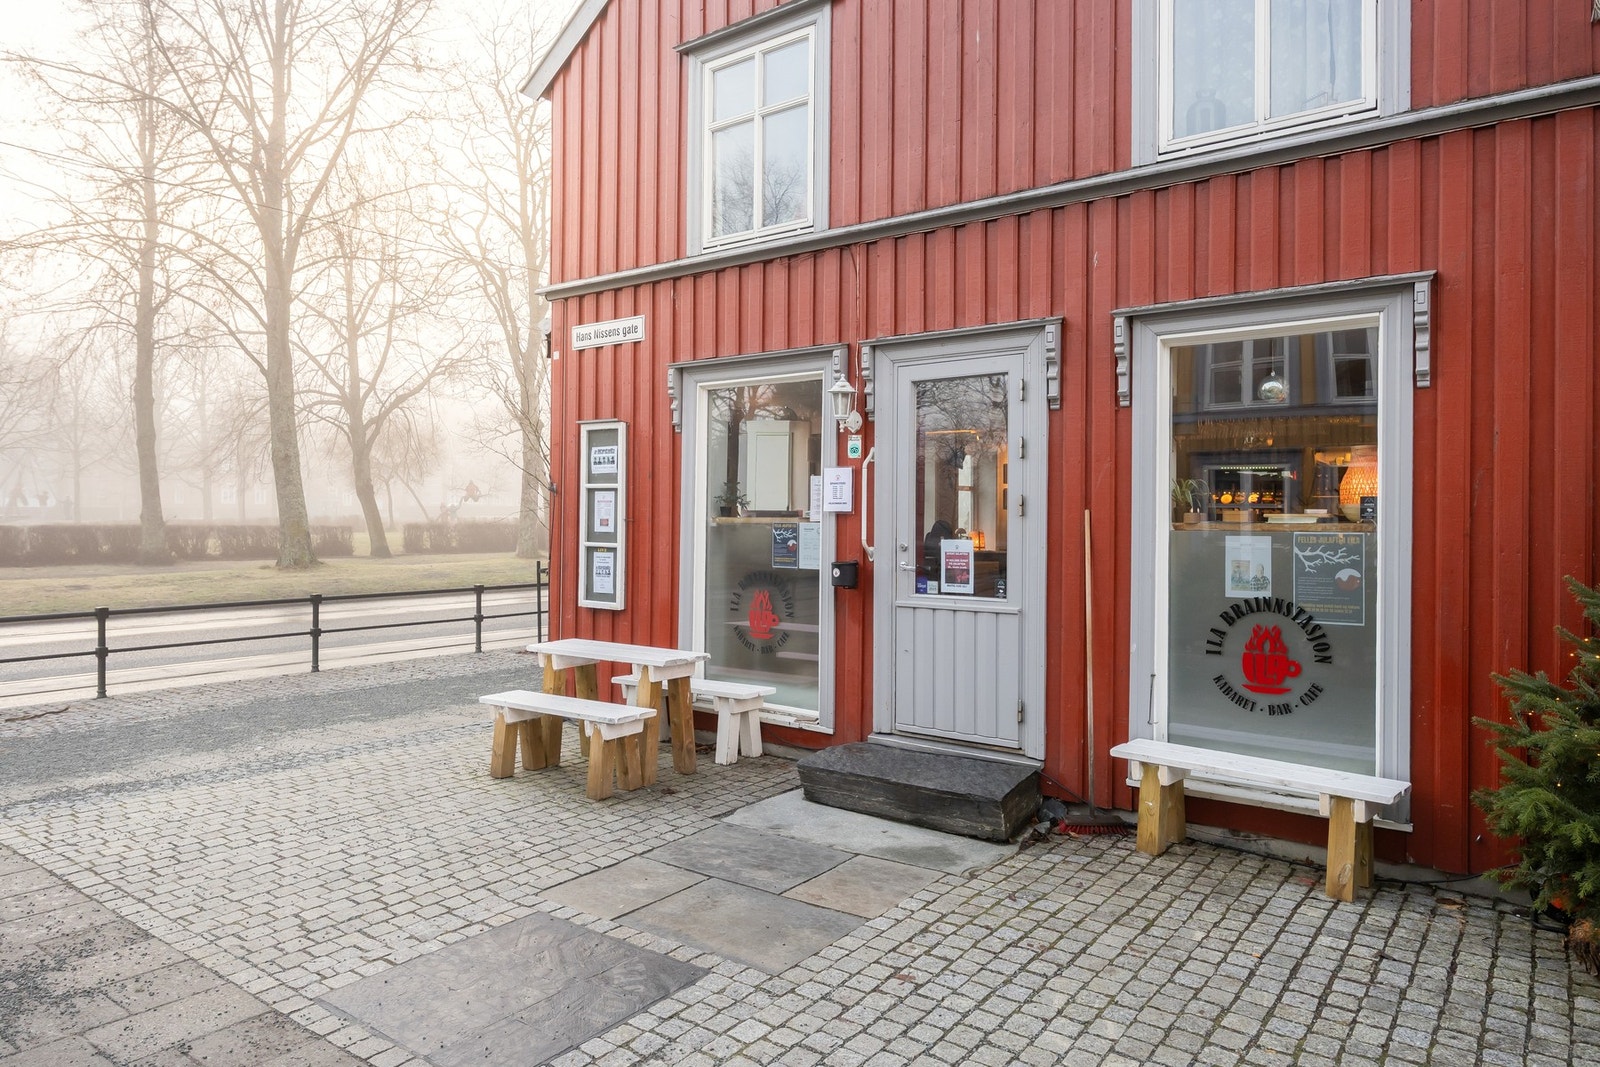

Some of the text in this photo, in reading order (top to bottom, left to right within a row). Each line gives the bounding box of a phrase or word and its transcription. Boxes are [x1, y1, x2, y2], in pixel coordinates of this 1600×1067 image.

[576, 324, 639, 342] Hans Nissens gate
[1205, 596, 1333, 665] ILA BRAINNSTASJON
[1212, 674, 1257, 712] KABARET
[1268, 702, 1293, 716] BAR
